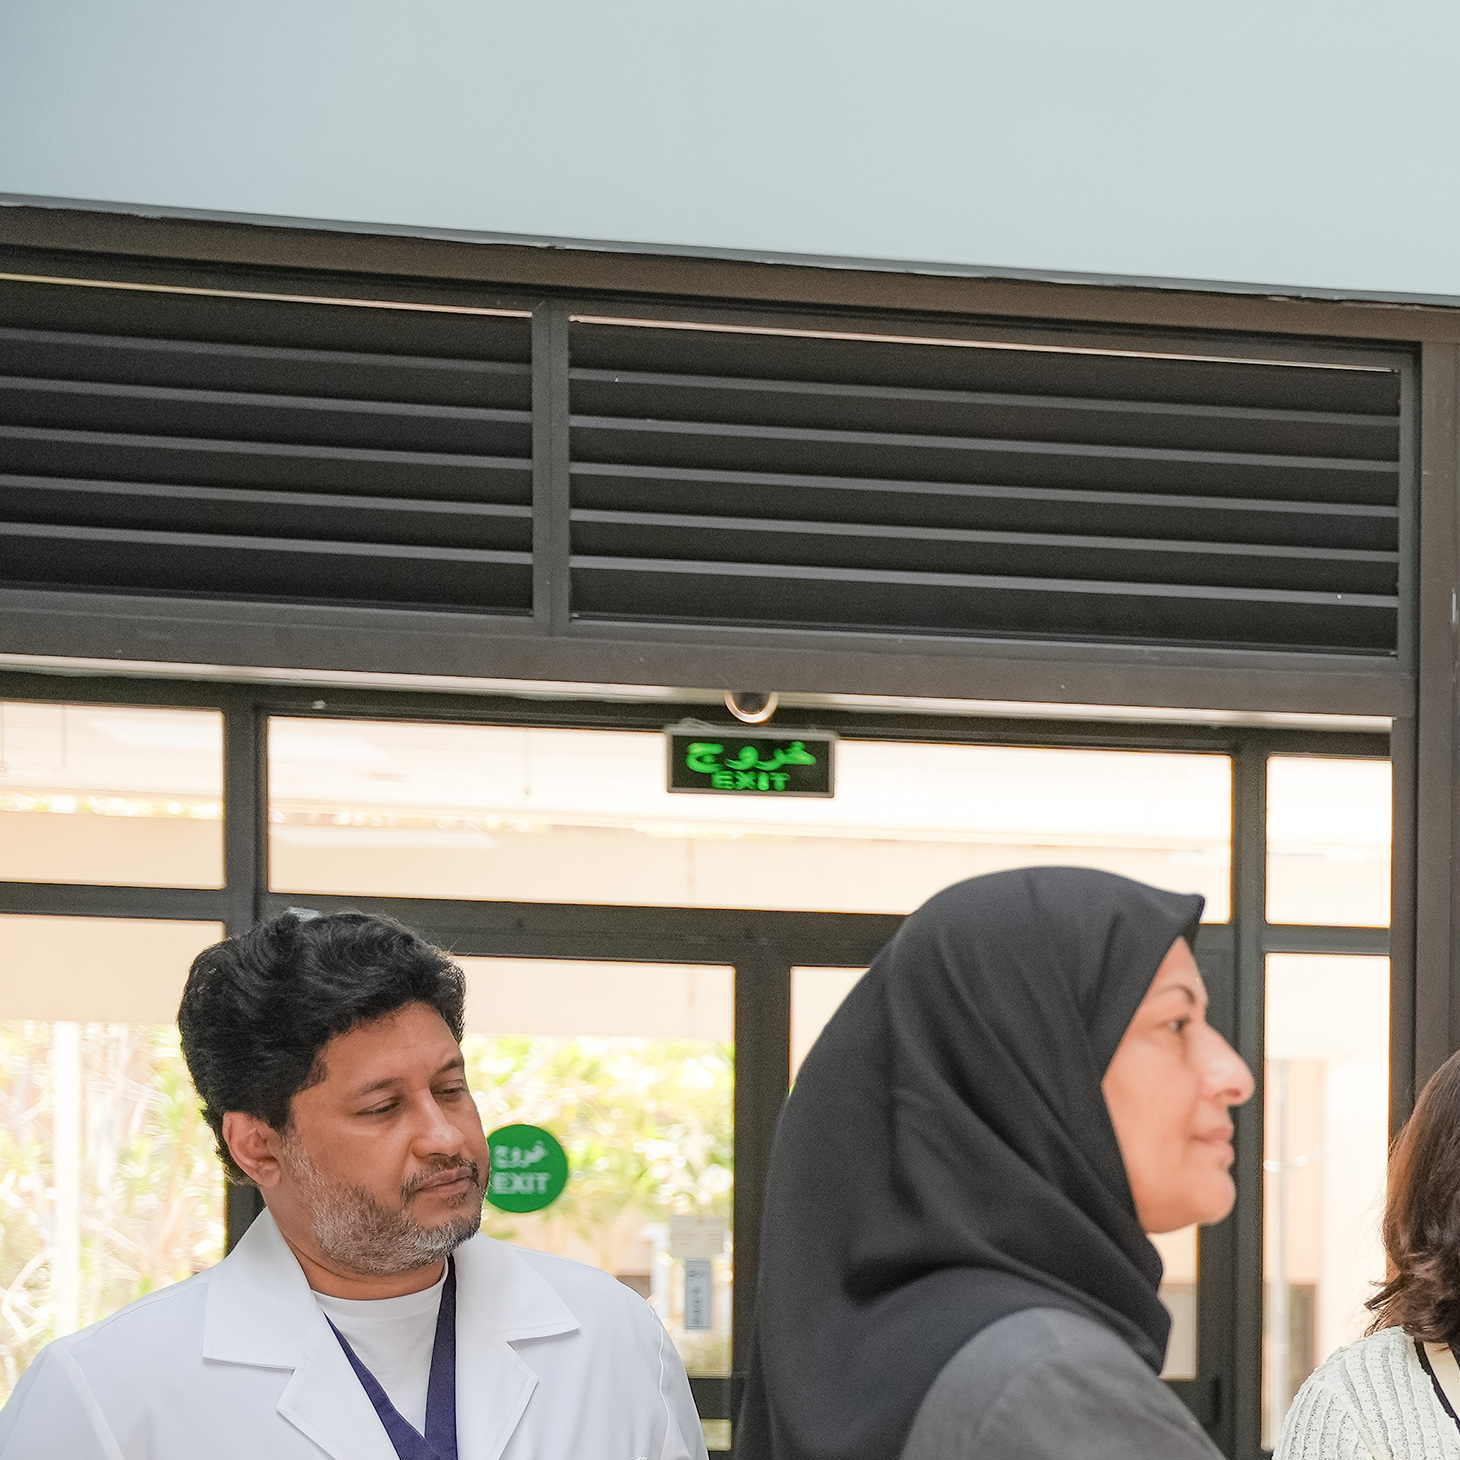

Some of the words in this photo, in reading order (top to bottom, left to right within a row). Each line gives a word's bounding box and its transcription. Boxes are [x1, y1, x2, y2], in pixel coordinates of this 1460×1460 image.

[686, 741, 816, 774] خروج
[712, 771, 789, 791] EXIT
[493, 1140, 549, 1169] خروج
[493, 1172, 551, 1194] EXIT
